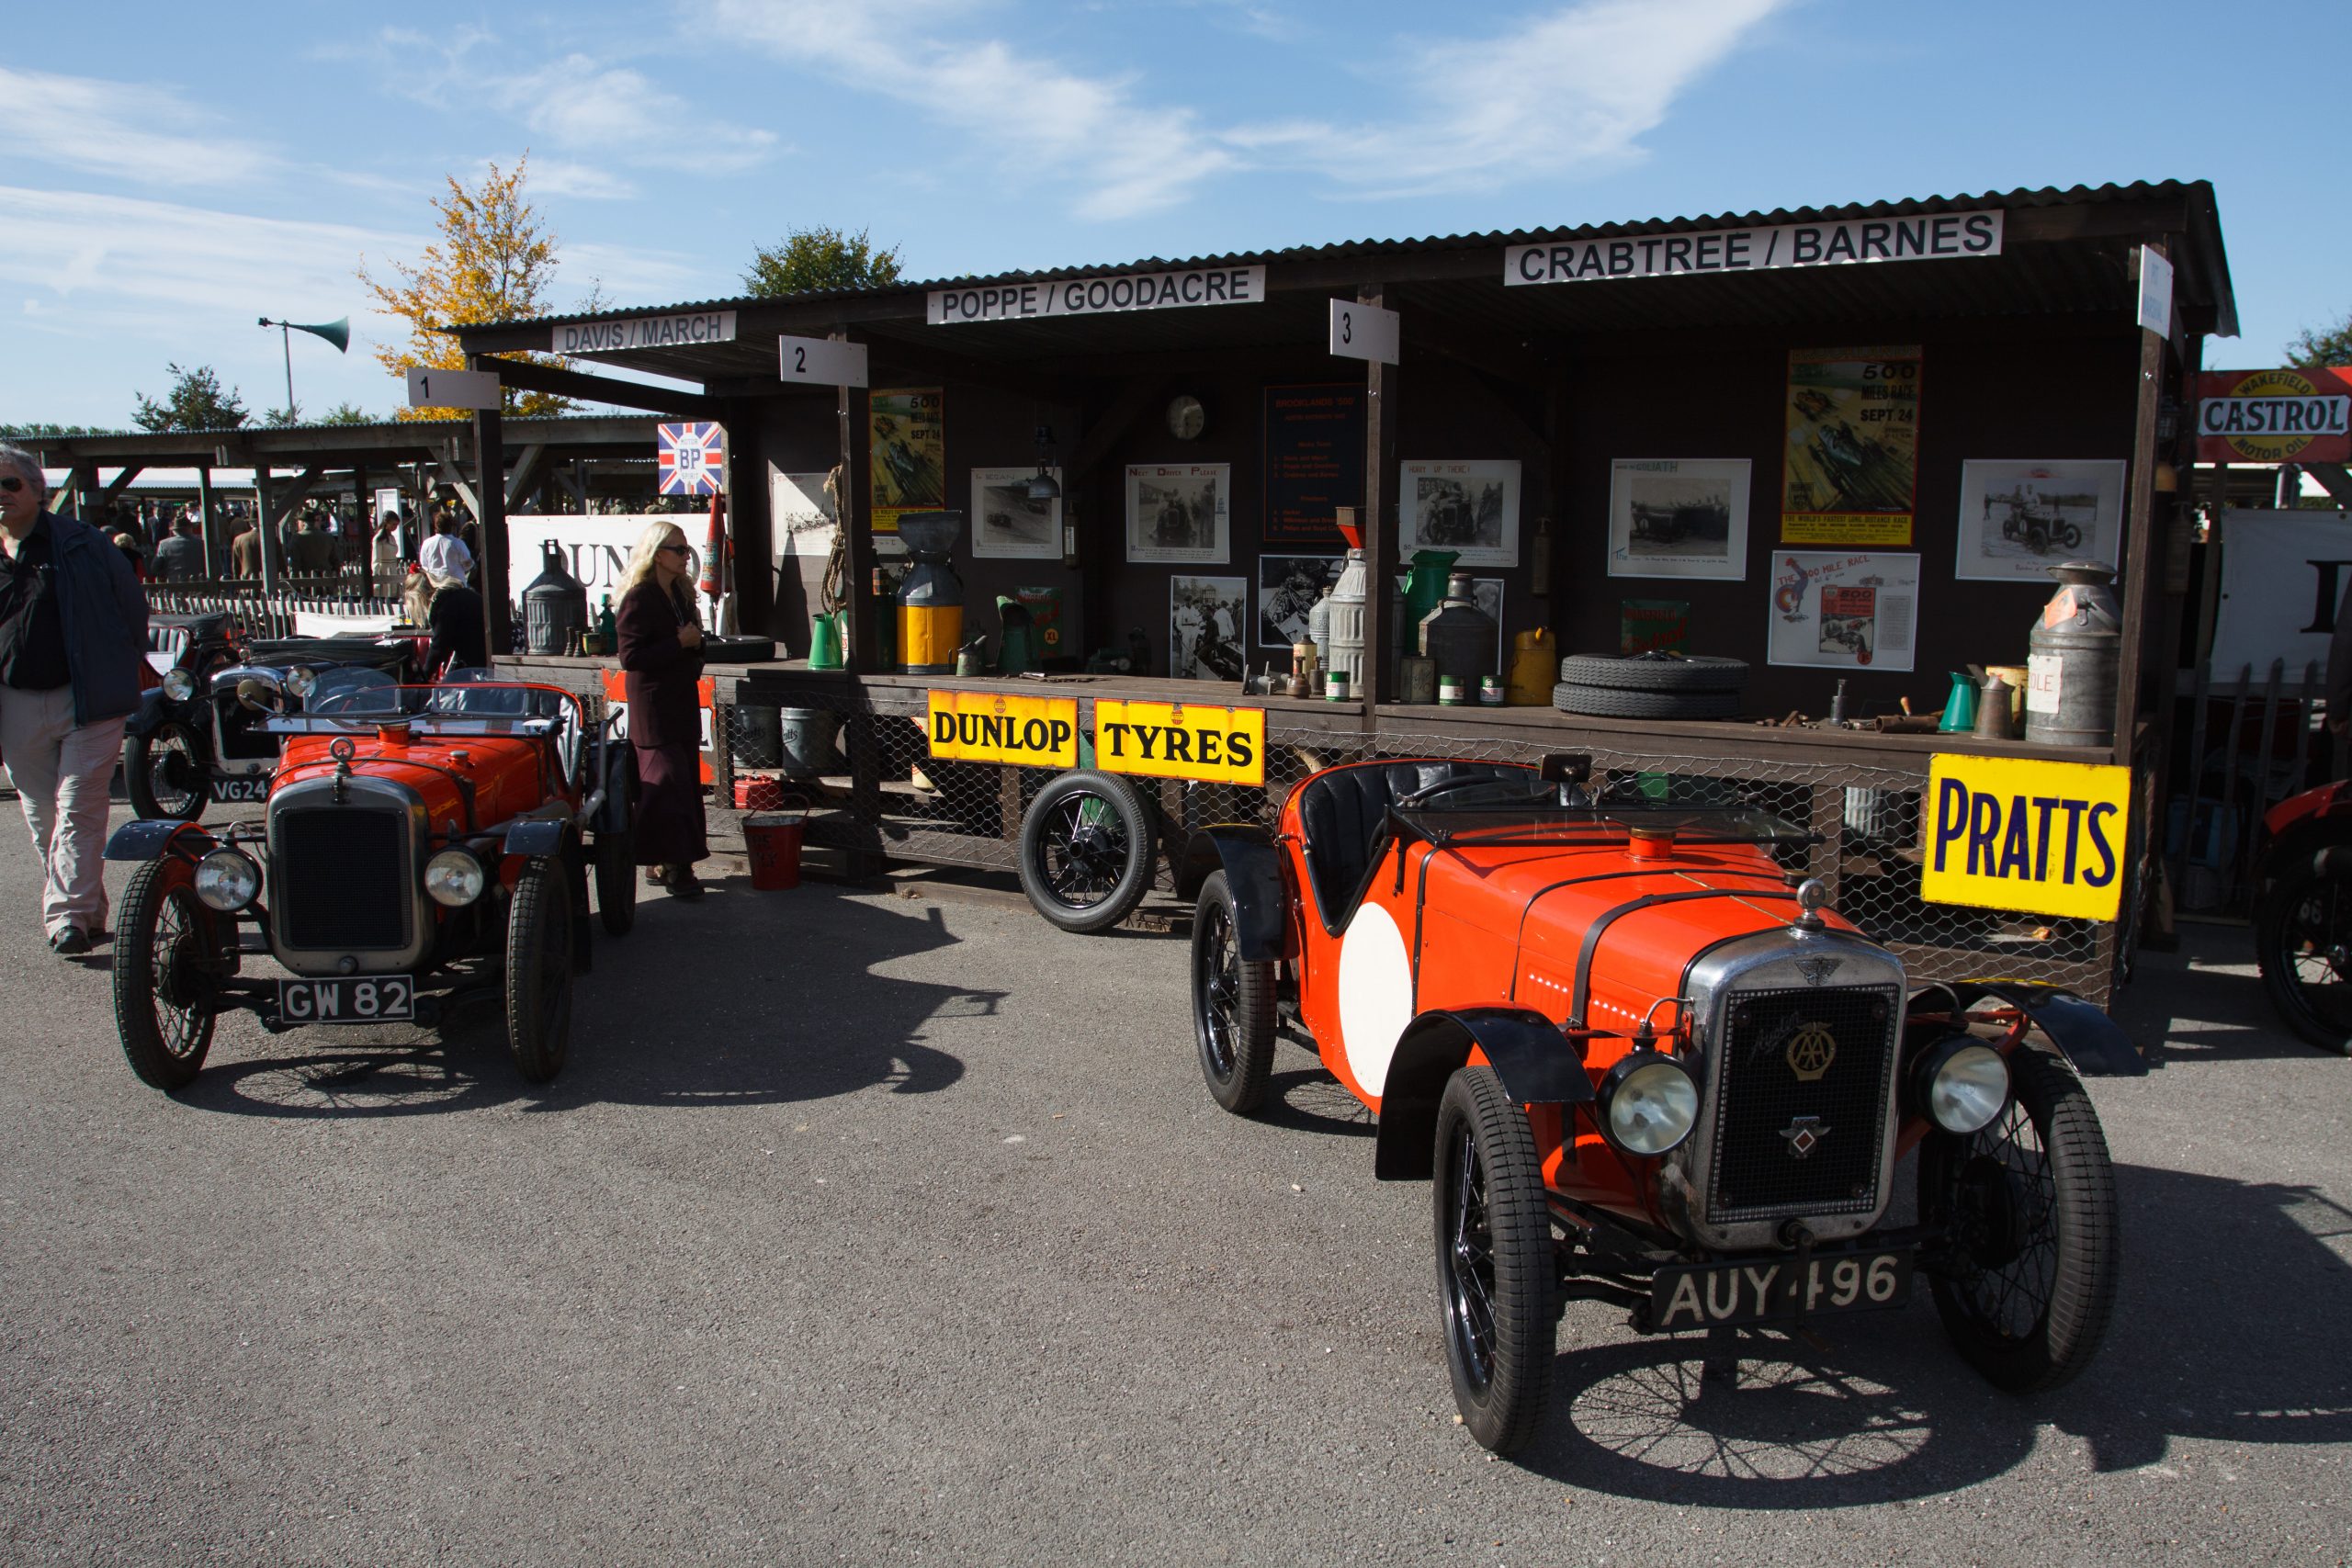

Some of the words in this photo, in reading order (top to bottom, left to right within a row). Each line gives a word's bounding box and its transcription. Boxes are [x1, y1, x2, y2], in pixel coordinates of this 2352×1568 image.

[1520, 232, 1751, 281] CRABTREE
[1764, 231, 1779, 265] /
[1792, 215, 1994, 264] BARNES
[943, 286, 1037, 320] POPPE
[1046, 284, 1055, 313] /
[1064, 270, 1250, 310] GOODACRE
[566, 323, 624, 351] DAVIS
[630, 321, 637, 345] /
[643, 315, 721, 344] MARCH
[1342, 312, 1351, 344] 3
[795, 347, 807, 373] 2
[1862, 365, 1916, 380] 500
[421, 377, 430, 399] 1
[1861, 385, 1889, 400] MILES
[1891, 384, 1915, 400] RACE
[2238, 373, 2312, 395] WAKEFIELD
[910, 396, 941, 409] 500
[1898, 408, 1914, 422] 24
[2205, 400, 2345, 432] CASTROL
[932, 430, 942, 439] 24
[680, 449, 700, 469] BP
[2234, 437, 2282, 460] MOTOR
[2286, 436, 2308, 455] OIL
[1635, 460, 1678, 472] GOLIATH
[1779, 574, 1795, 586] THE
[1822, 560, 1843, 573] MILE
[1847, 555, 1871, 567] RACE
[1046, 631, 1057, 641] XL
[933, 711, 1071, 753] DUNLOP
[1103, 722, 1253, 767] TYRES
[213, 780, 268, 801] VG24
[1934, 777, 2119, 887] PRATTS
[286, 984, 339, 1018] GW
[354, 981, 409, 1015] 82
[1661, 1264, 1781, 1326] AUY
[1789, 1255, 1899, 1311] 496
